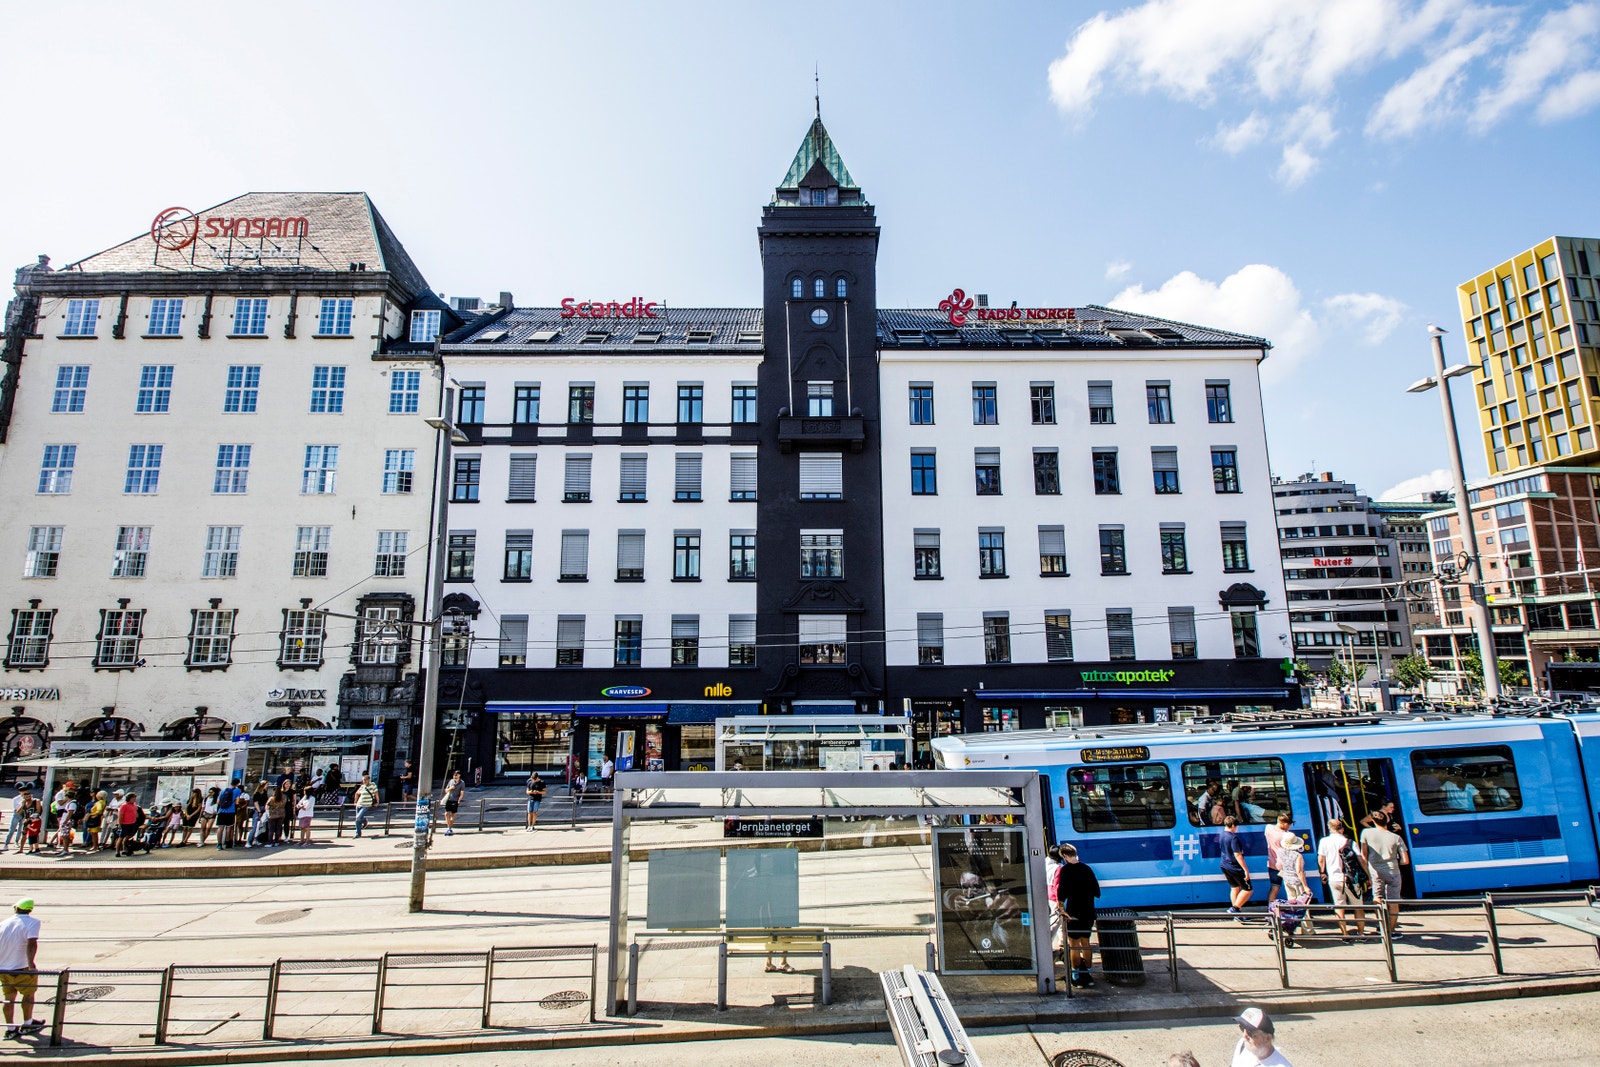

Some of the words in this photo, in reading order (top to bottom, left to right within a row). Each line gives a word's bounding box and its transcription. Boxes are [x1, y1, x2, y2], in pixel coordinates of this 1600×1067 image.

[560, 297, 657, 317] Scandic
[977, 308, 1021, 320] RADIO
[1026, 308, 1075, 319] NORGE
[28, 688, 60, 701] PIZZA
[704, 682, 733, 697] nille
[1156, 713, 1168, 722] 24
[736, 822, 811, 834] Jernbanetorget
